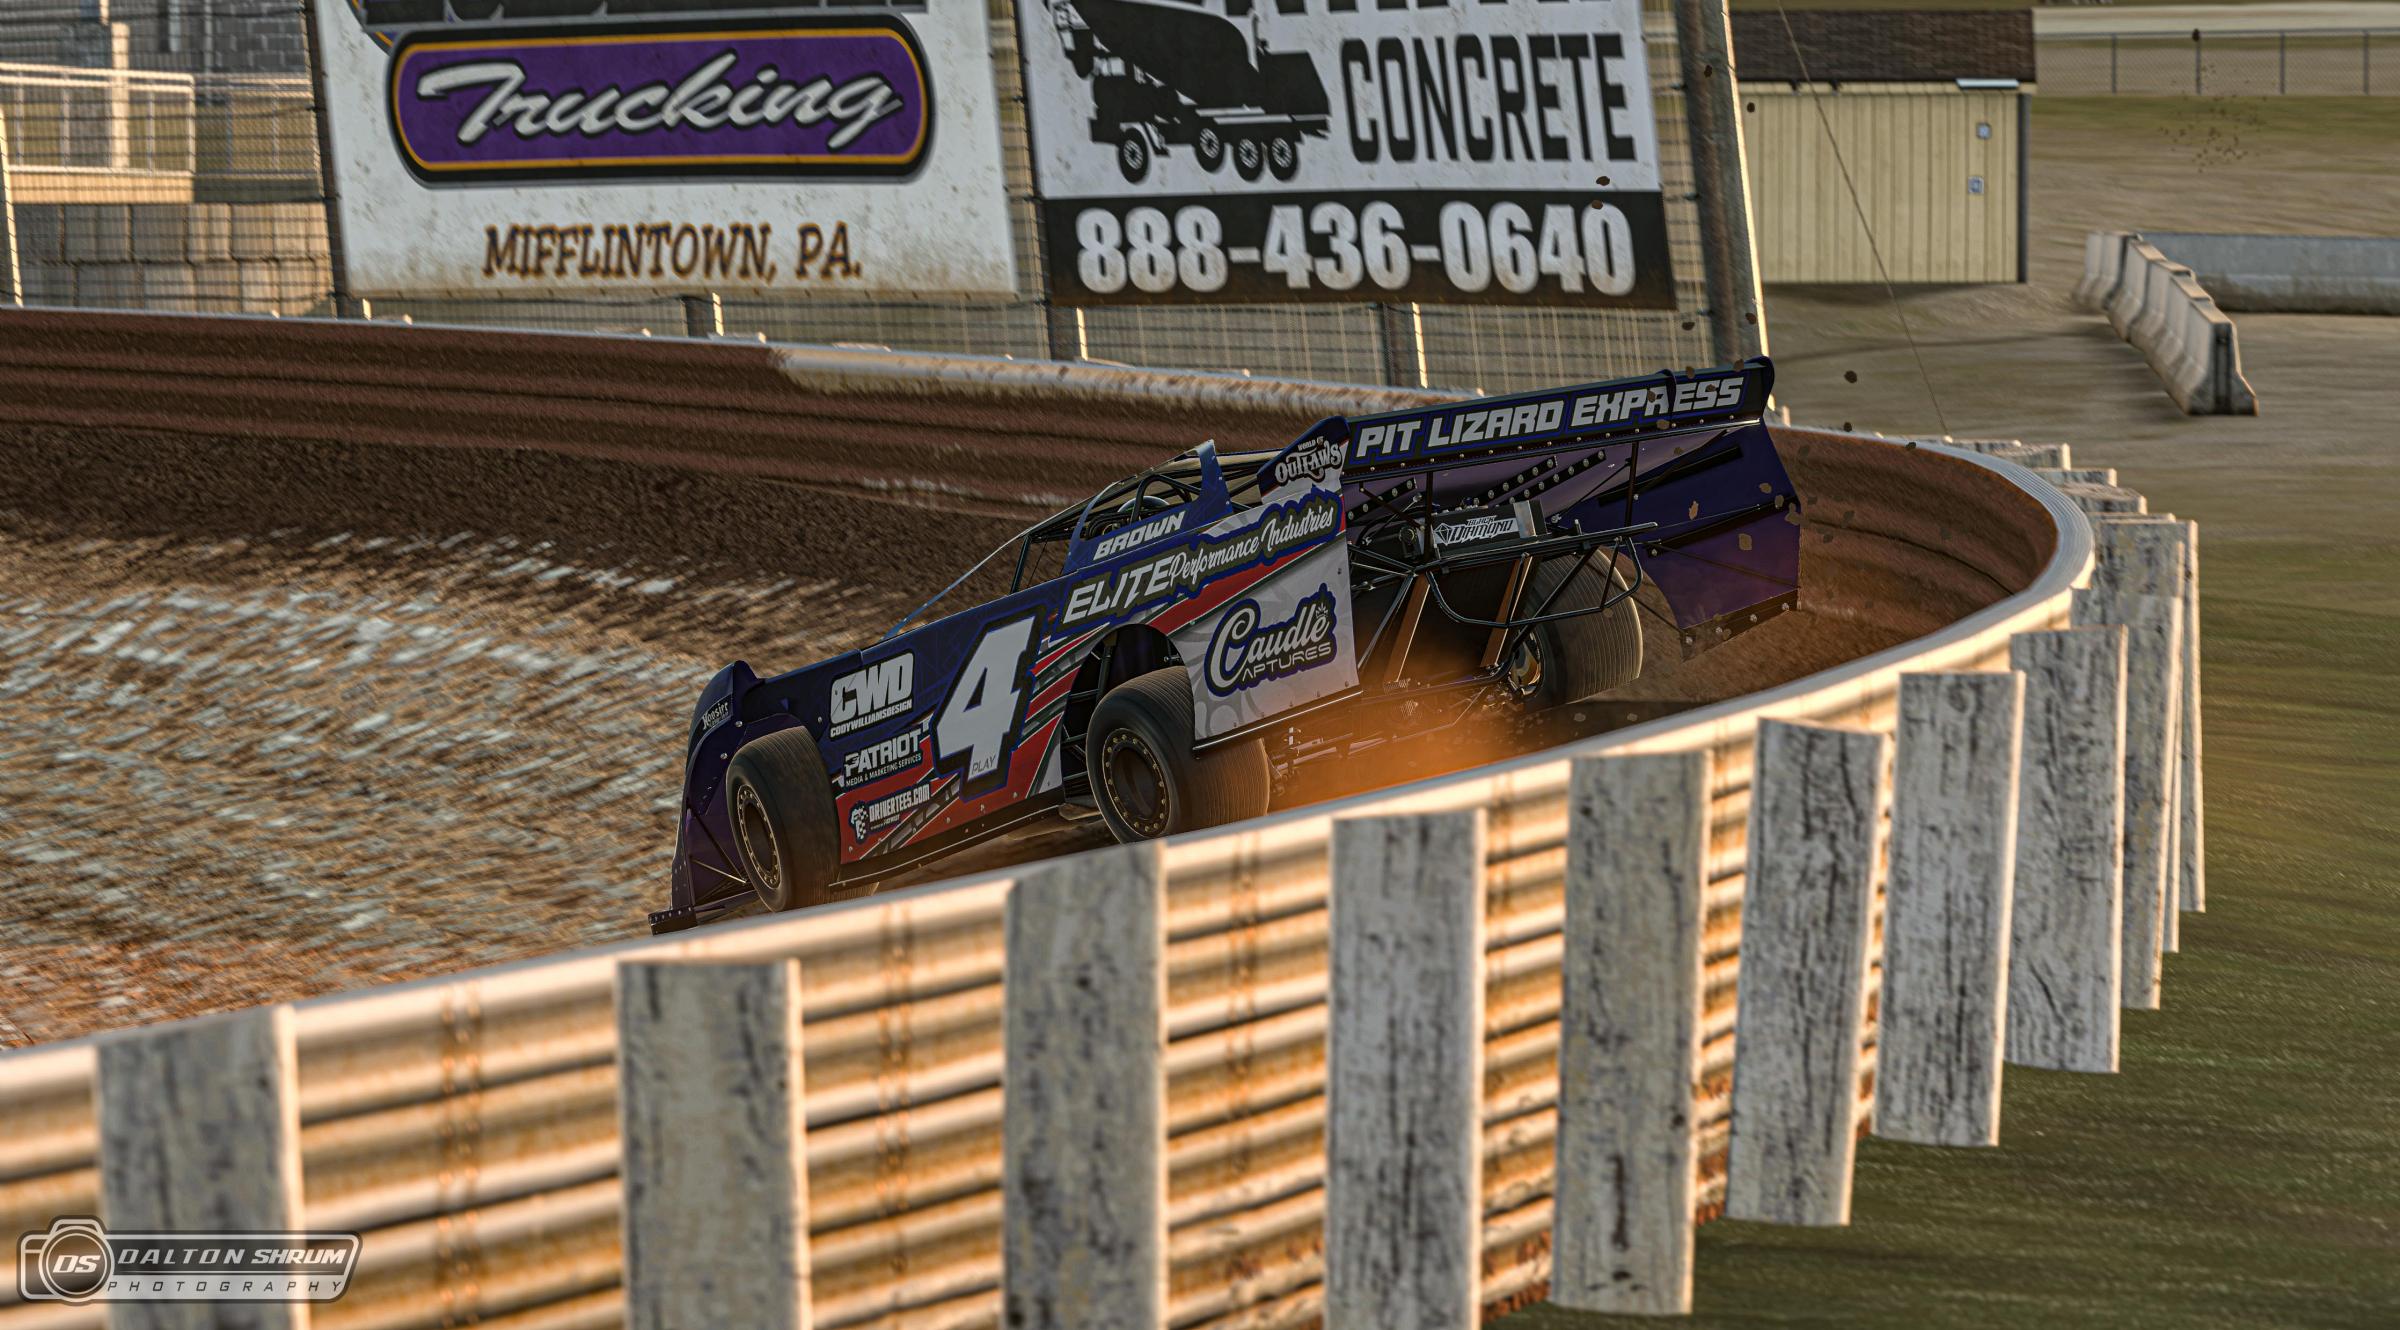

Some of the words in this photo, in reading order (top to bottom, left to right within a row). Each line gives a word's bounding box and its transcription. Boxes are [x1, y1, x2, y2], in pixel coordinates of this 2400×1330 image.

[416, 49, 903, 151] Trucking
[1340, 33, 1637, 164] CONCRETE
[483, 222, 777, 283] MIFFLINTOWN,
[795, 221, 863, 279] PA.
[1075, 201, 1636, 295] 888-436-0640
[1356, 420, 1421, 458] PIT
[1428, 400, 1565, 448] LIZARD
[1570, 376, 1745, 427] EXPRESS
[1063, 554, 1176, 624] ELITE
[1169, 537, 1260, 588] Performance
[1260, 506, 1335, 551] Industries
[1093, 510, 1187, 561] BROWN
[1449, 519, 1514, 542] DIAMOND
[1210, 603, 1331, 688] Caudle
[830, 652, 914, 724] CWD
[936, 615, 1035, 782] 4
[844, 728, 921, 777] PATRIOT
[846, 773, 864, 788] MEDIA
